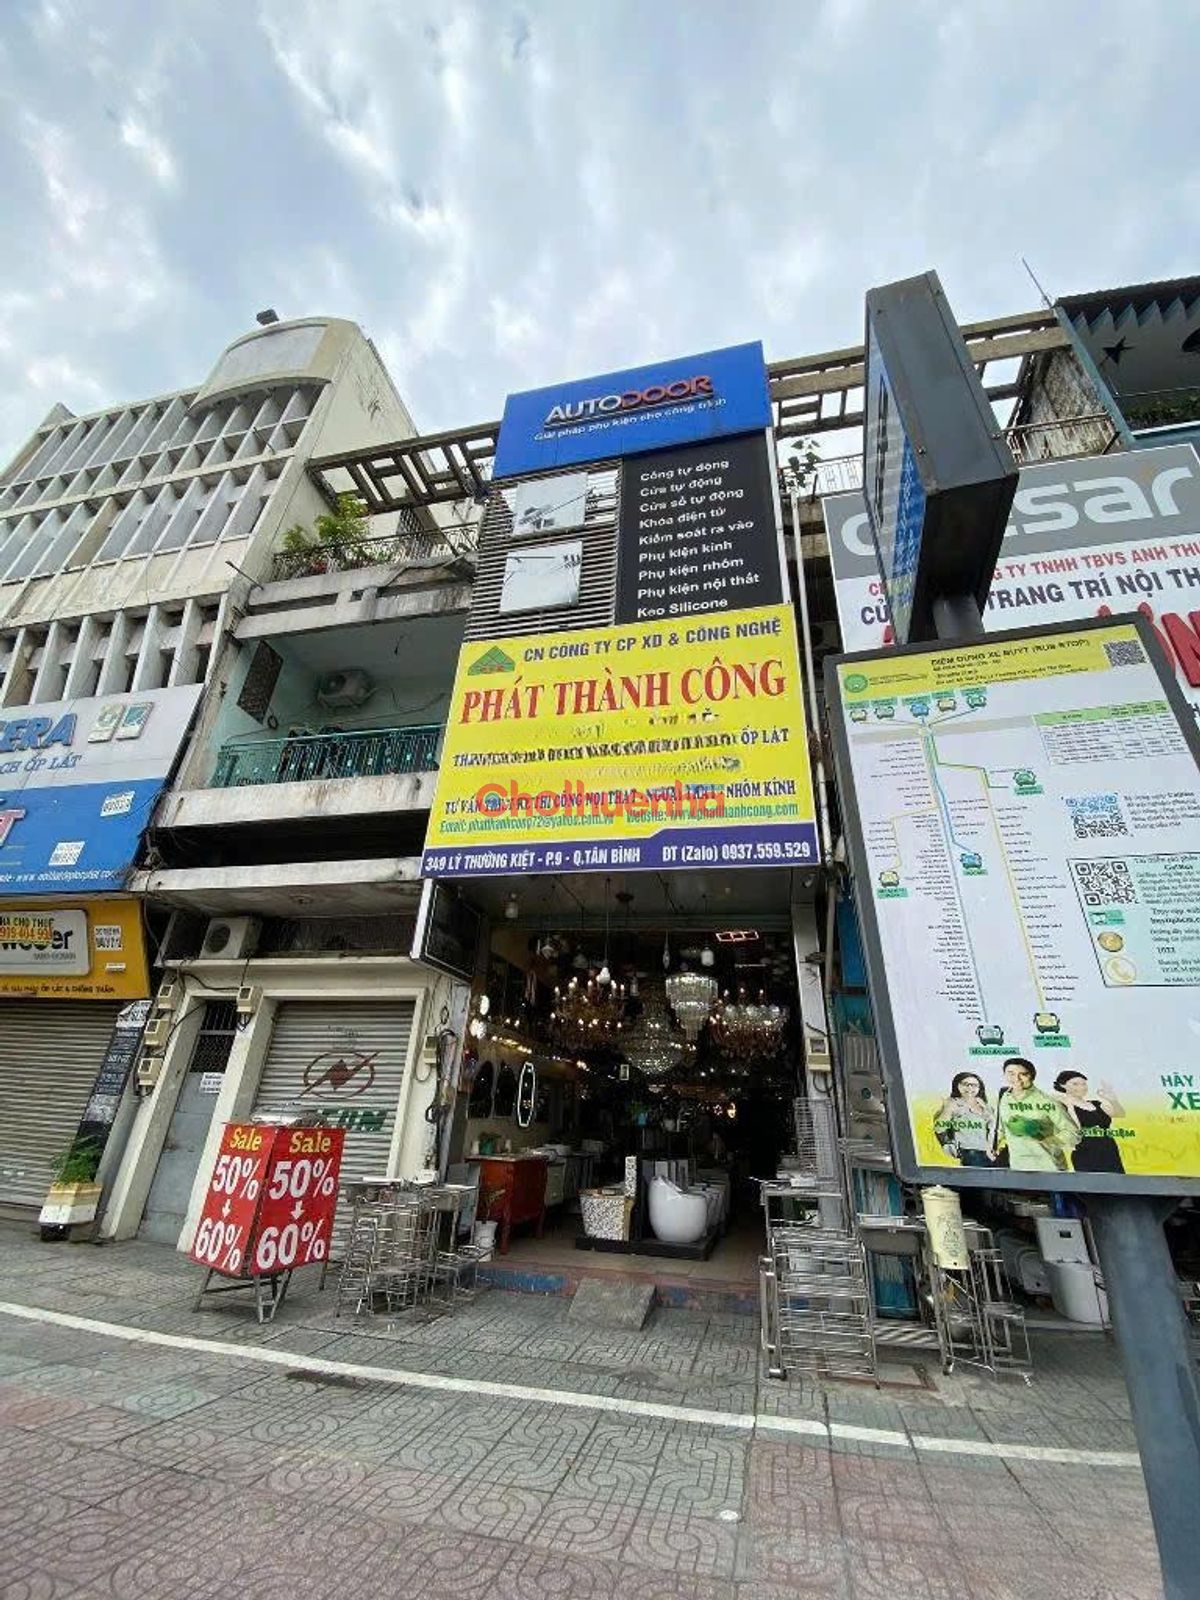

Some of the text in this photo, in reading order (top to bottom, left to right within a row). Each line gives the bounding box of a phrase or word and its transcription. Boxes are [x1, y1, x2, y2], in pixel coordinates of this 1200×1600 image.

[546, 375, 713, 424] AUTODOOR
[640, 410, 662, 422] cho
[640, 477, 722, 497] Cửa tự động
[639, 489, 744, 513] Cửa sổ tự động
[677, 511, 706, 523] điện
[710, 507, 726, 517] tử
[710, 525, 724, 534] ra
[728, 520, 754, 532] vào
[639, 552, 665, 562] Phụ
[669, 546, 698, 559] kiện
[1005, 564, 1026, 578] TY
[1030, 558, 1079, 575] TNHH
[1080, 551, 1127, 567] TBVS
[1132, 547, 1168, 564] ANH
[639, 570, 665, 581] Phụ
[669, 564, 698, 576] kiện
[637, 571, 760, 599] Phụ kiện nội thất
[986, 583, 1065, 610] TRANG
[1068, 572, 1110, 600] TRÍ
[1116, 568, 1164, 598] NỘI
[637, 598, 728, 618] Keo Silicone
[524, 617, 781, 662] CN CÔNG TY CP XD & CÔNG NGHỆ
[458, 655, 786, 725] PHÁT THÀNH CÔNG
[740, 724, 789, 745] ỐP LÁT
[0, 751, 82, 774] CH ỐP LÁT
[726, 778, 761, 798] NHÔM
[764, 776, 796, 796] KÍNH
[448, 853, 462, 870] LÝ
[464, 852, 507, 870] THƯỜNG
[510, 849, 535, 870] KIỆT
[546, 851, 563, 866] P.9
[573, 846, 607, 866] Q.TÂN
[611, 846, 640, 864] BÌNH
[681, 845, 718, 862] (Zalo)
[721, 842, 810, 860] 0937.559.529
[1161, 1072, 1193, 1087] HÃY
[1008, 1102, 1033, 1112] TIỆN
[229, 1127, 262, 1151] Sale
[289, 1131, 332, 1153] Sale
[212, 1154, 261, 1200] 50%
[269, 1157, 334, 1200] 50%
[195, 1217, 243, 1271] 60%
[256, 1218, 325, 1270] 60%
